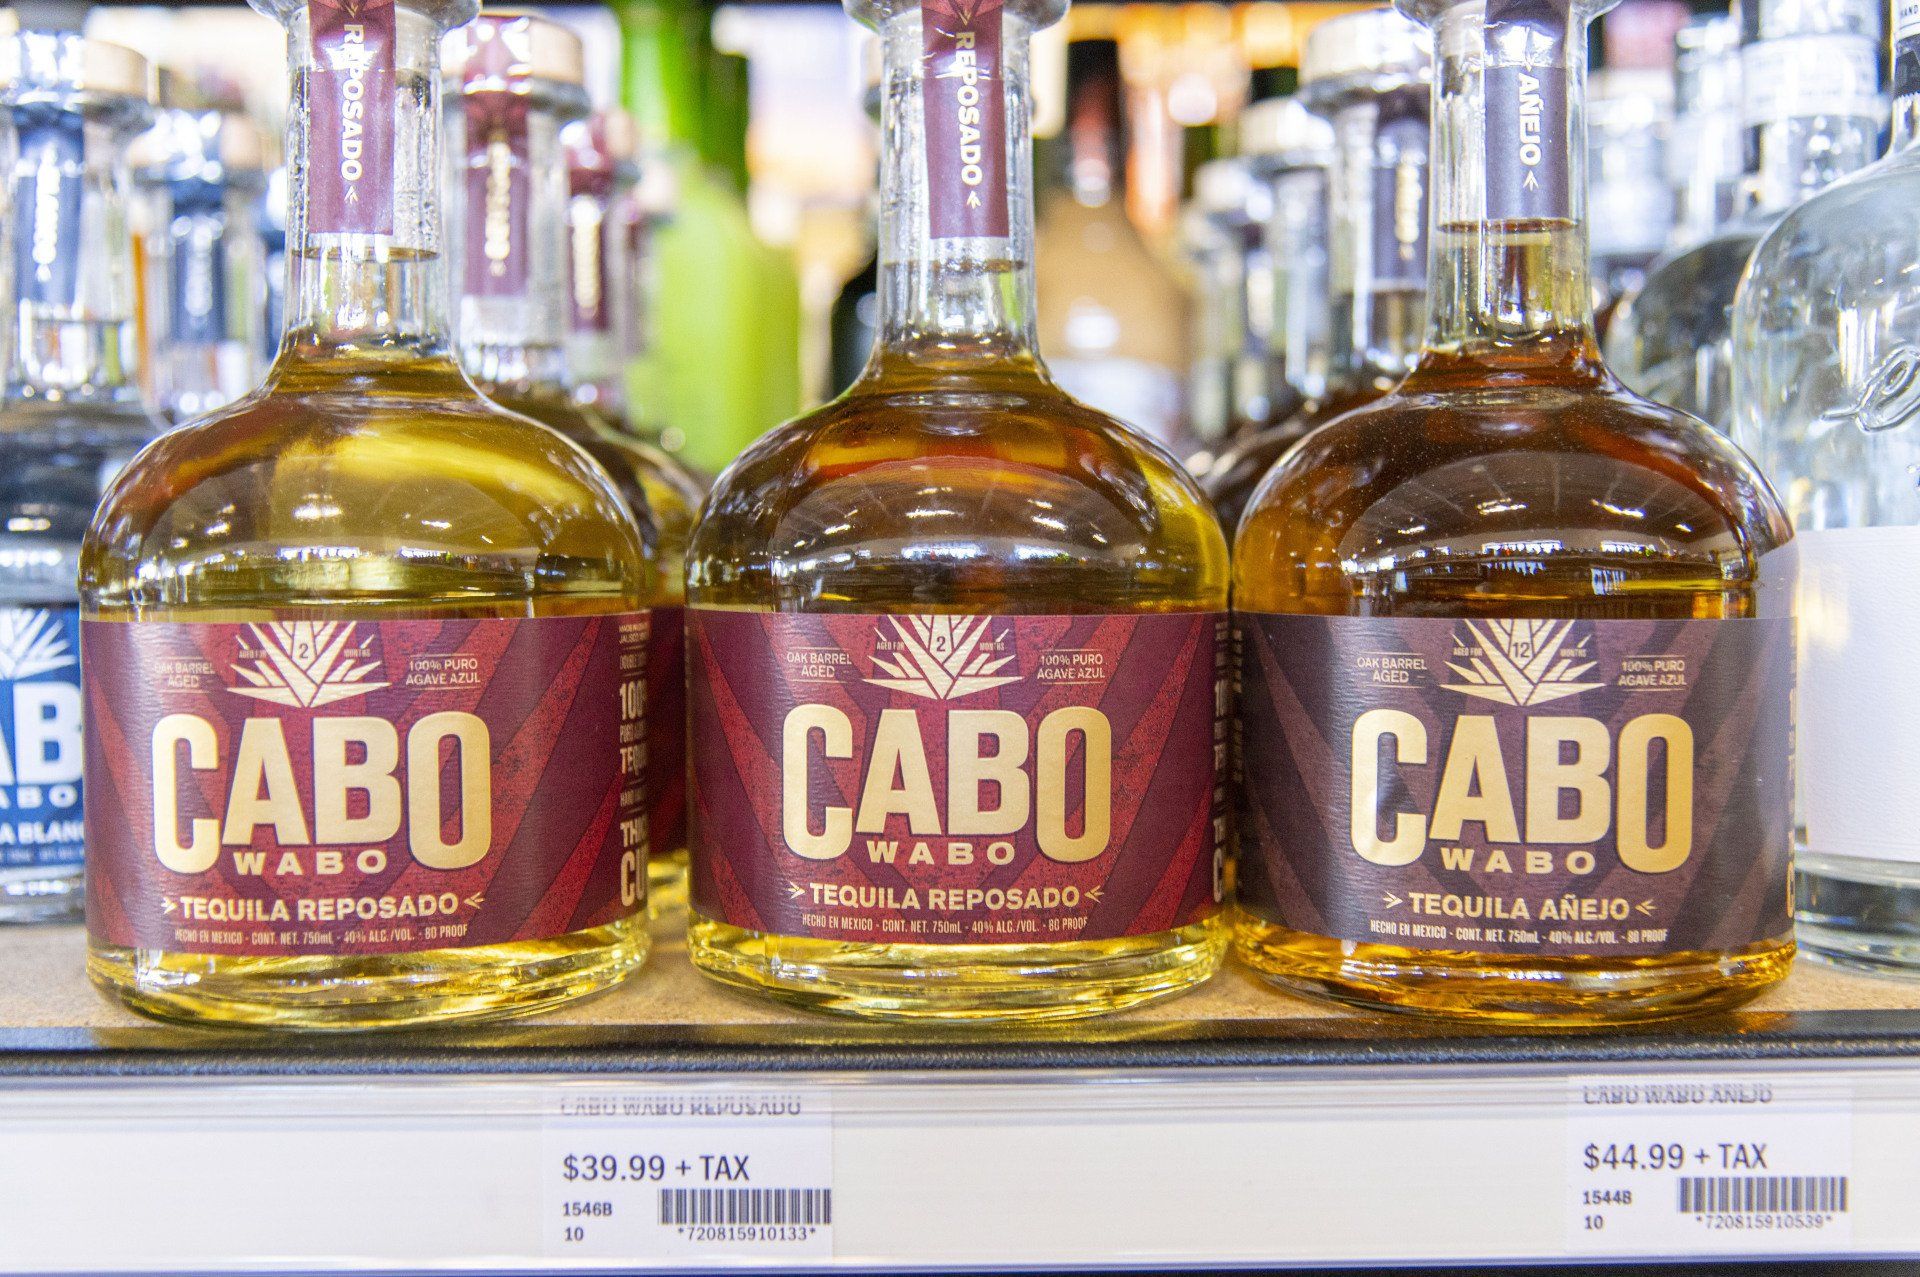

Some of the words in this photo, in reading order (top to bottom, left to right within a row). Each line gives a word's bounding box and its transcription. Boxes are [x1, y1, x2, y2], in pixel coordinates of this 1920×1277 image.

[956, 31, 983, 187] REPOSADO
[1518, 72, 1544, 167] AÑEJO
[300, 643, 309, 659] 2
[876, 641, 892, 651] AGED
[936, 636, 946, 652] 2
[1512, 642, 1531, 658] 12
[409, 660, 441, 671] 100%
[444, 658, 478, 670] PURO
[787, 652, 807, 663] OAK
[810, 653, 852, 664] BARREL
[1040, 655, 1070, 666] 100%
[1072, 653, 1103, 666] PURO
[1356, 656, 1379, 668] OAK
[1381, 658, 1427, 670] BARREL
[1621, 661, 1652, 671] 100%
[1654, 660, 1685, 672] PURO
[405, 673, 447, 685] AGAVE
[450, 672, 481, 683] AZUL
[801, 665, 835, 678] AGED
[1037, 669, 1076, 680] AGAVE
[1077, 667, 1105, 679] AZUL
[1372, 670, 1409, 683] AGED
[167, 675, 200, 688] AGED
[1618, 675, 1657, 686] AGAVE
[1659, 674, 1687, 685] AZUL
[783, 704, 1112, 863] CABO
[1352, 709, 1694, 873] CABO
[152, 711, 492, 874] CABO
[18, 820, 84, 844] BLAN
[866, 840, 1015, 866] WABO
[1440, 847, 1595, 875] WABO
[232, 850, 387, 876] WABO
[809, 882, 921, 910] TEQUILA
[928, 885, 1080, 911] REPOSADO
[180, 897, 290, 922] TEQUILA
[297, 893, 458, 921] REPOSADO
[1408, 892, 1530, 919] TEQUILA
[1538, 893, 1630, 920] AÑEJO
[802, 913, 826, 928] HECHO
[828, 916, 838, 928] EN
[841, 917, 873, 931] MEXICO
[882, 919, 908, 932] CONT.
[910, 921, 929, 934] NET.
[971, 920, 994, 934] 40%
[1048, 918, 1060, 932] 80
[1062, 916, 1089, 930] PROOF
[200, 931, 209, 942] EN
[211, 932, 243, 944] MEXICO
[252, 932, 277, 944] CONT.
[280, 932, 300, 944] NET.
[344, 931, 366, 943] 40%
[425, 926, 437, 939] 80
[439, 924, 468, 938] PROOF
[1370, 920, 1397, 934] HECHO
[1400, 922, 1410, 936] EN
[1412, 924, 1447, 939] MEXICO
[1456, 927, 1482, 940] CONT.
[1485, 929, 1506, 942] NET.
[1549, 931, 1573, 944] 40%
[1641, 929, 1668, 943] PROOF
[1584, 1143, 1684, 1170] $44.99
[1717, 1143, 1768, 1169] TAX
[563, 1154, 665, 1181] $39.99
[699, 1155, 750, 1180] TAX
[562, 1202, 613, 1217] 1546B
[1585, 1215, 1604, 1230] 10
[565, 1226, 584, 1242] 10
